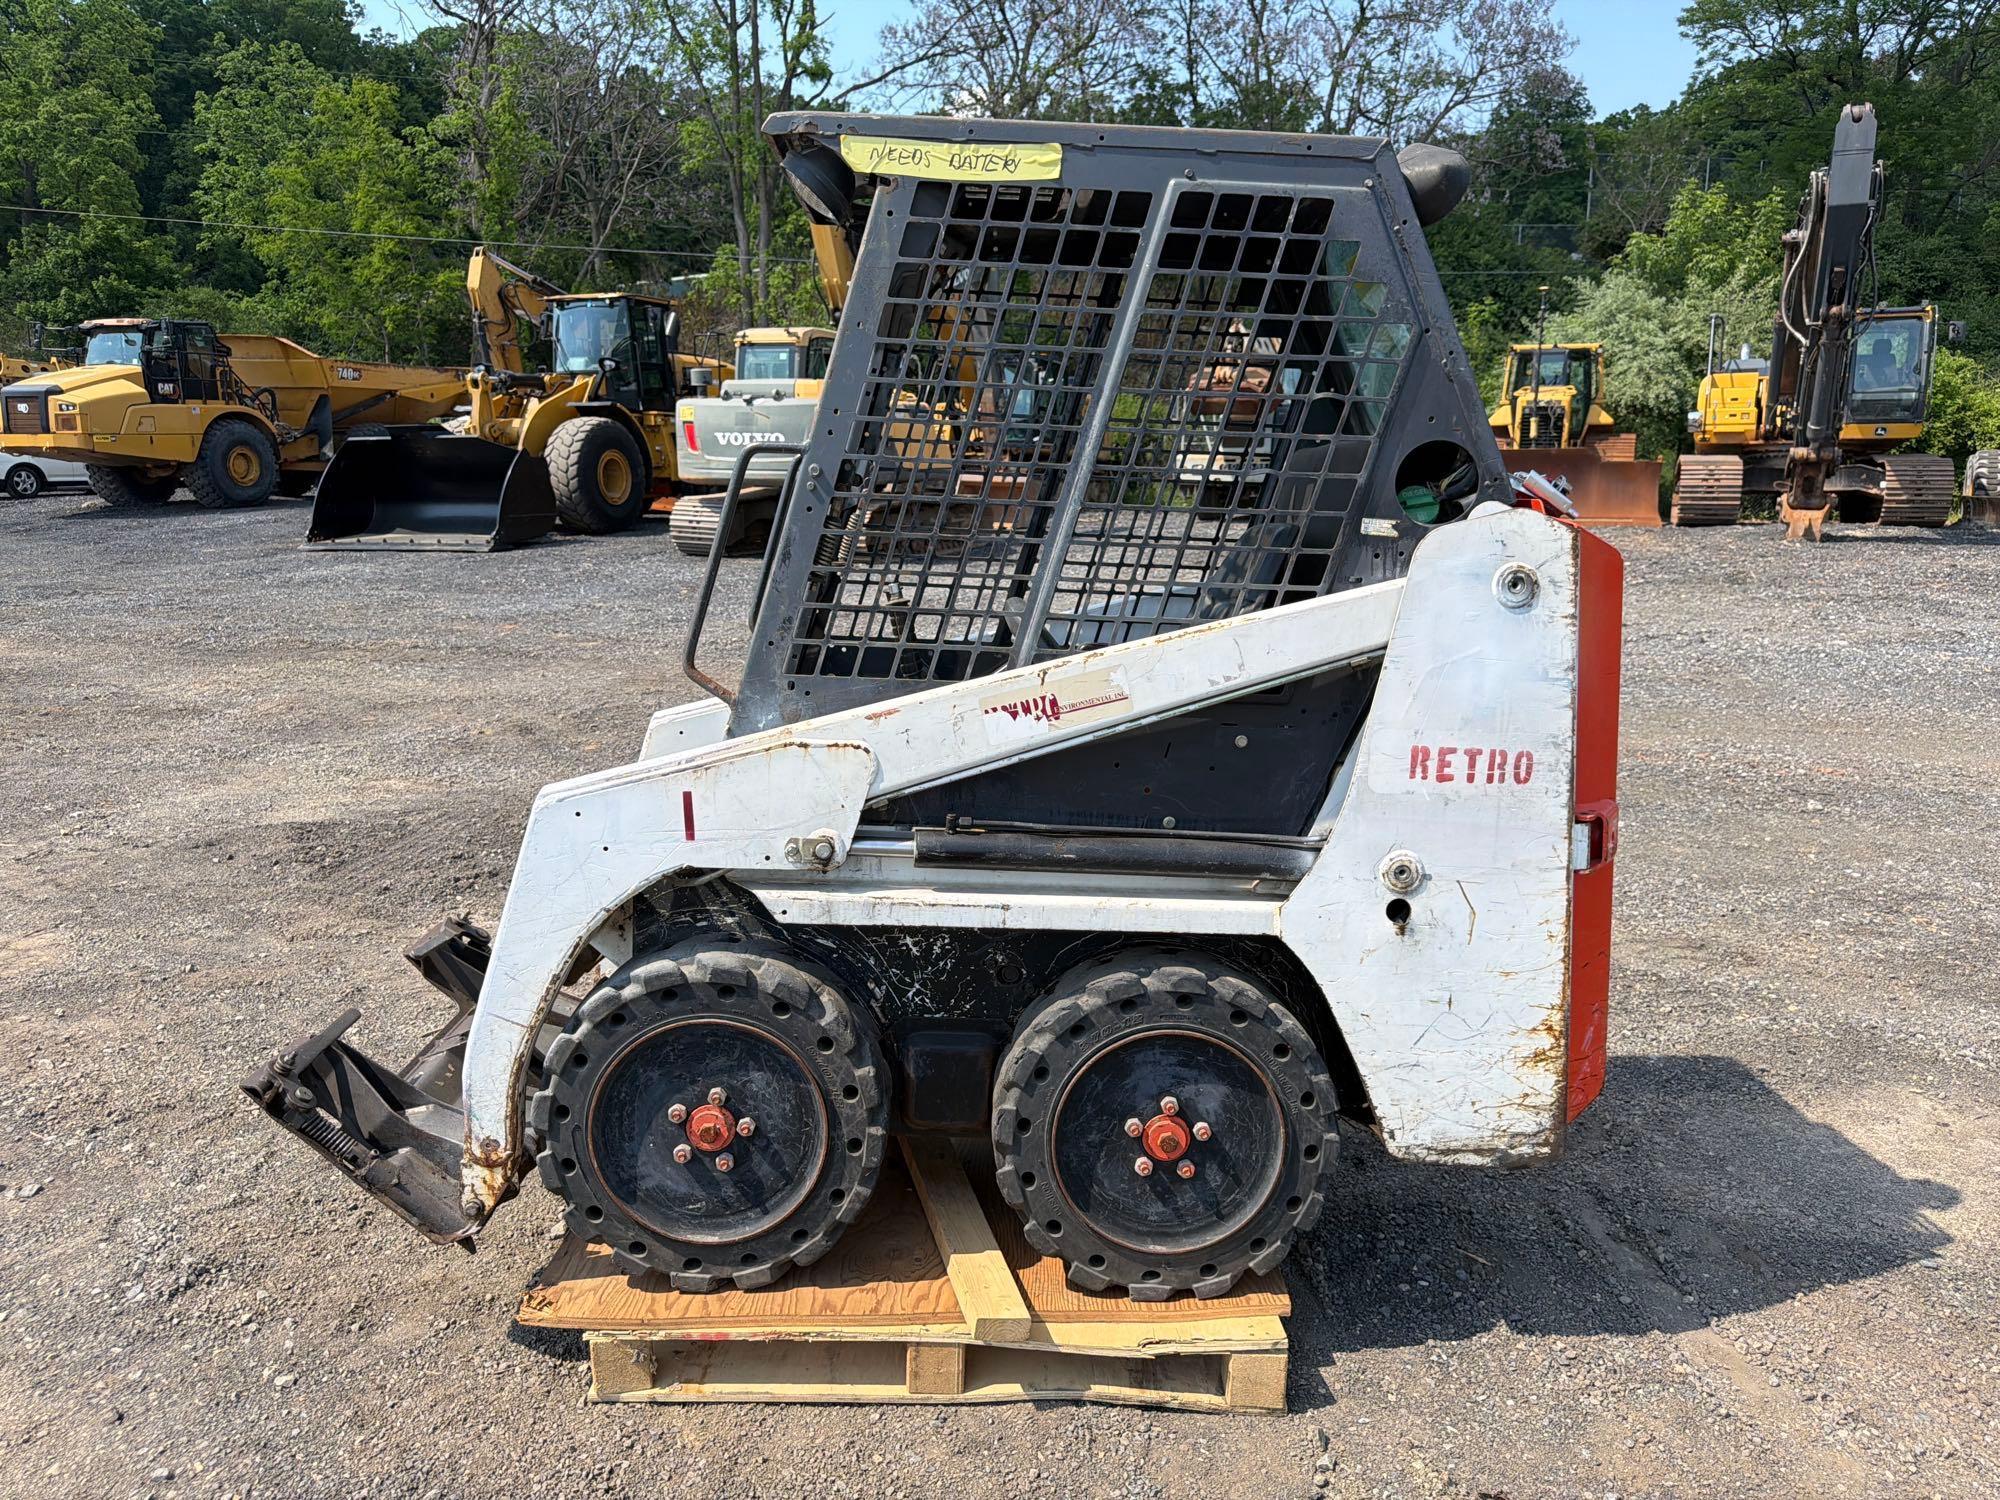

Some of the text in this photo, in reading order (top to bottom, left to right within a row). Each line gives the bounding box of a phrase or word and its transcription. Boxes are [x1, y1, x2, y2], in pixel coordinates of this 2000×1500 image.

[869, 140, 931, 169] NEEDS
[337, 367, 354, 380] 740
[158, 382, 174, 395] CAT
[714, 431, 786, 446] VOLVO
[1054, 694, 1113, 713] ENVIRONMENTAL
[1408, 744, 1535, 786] RETRO
